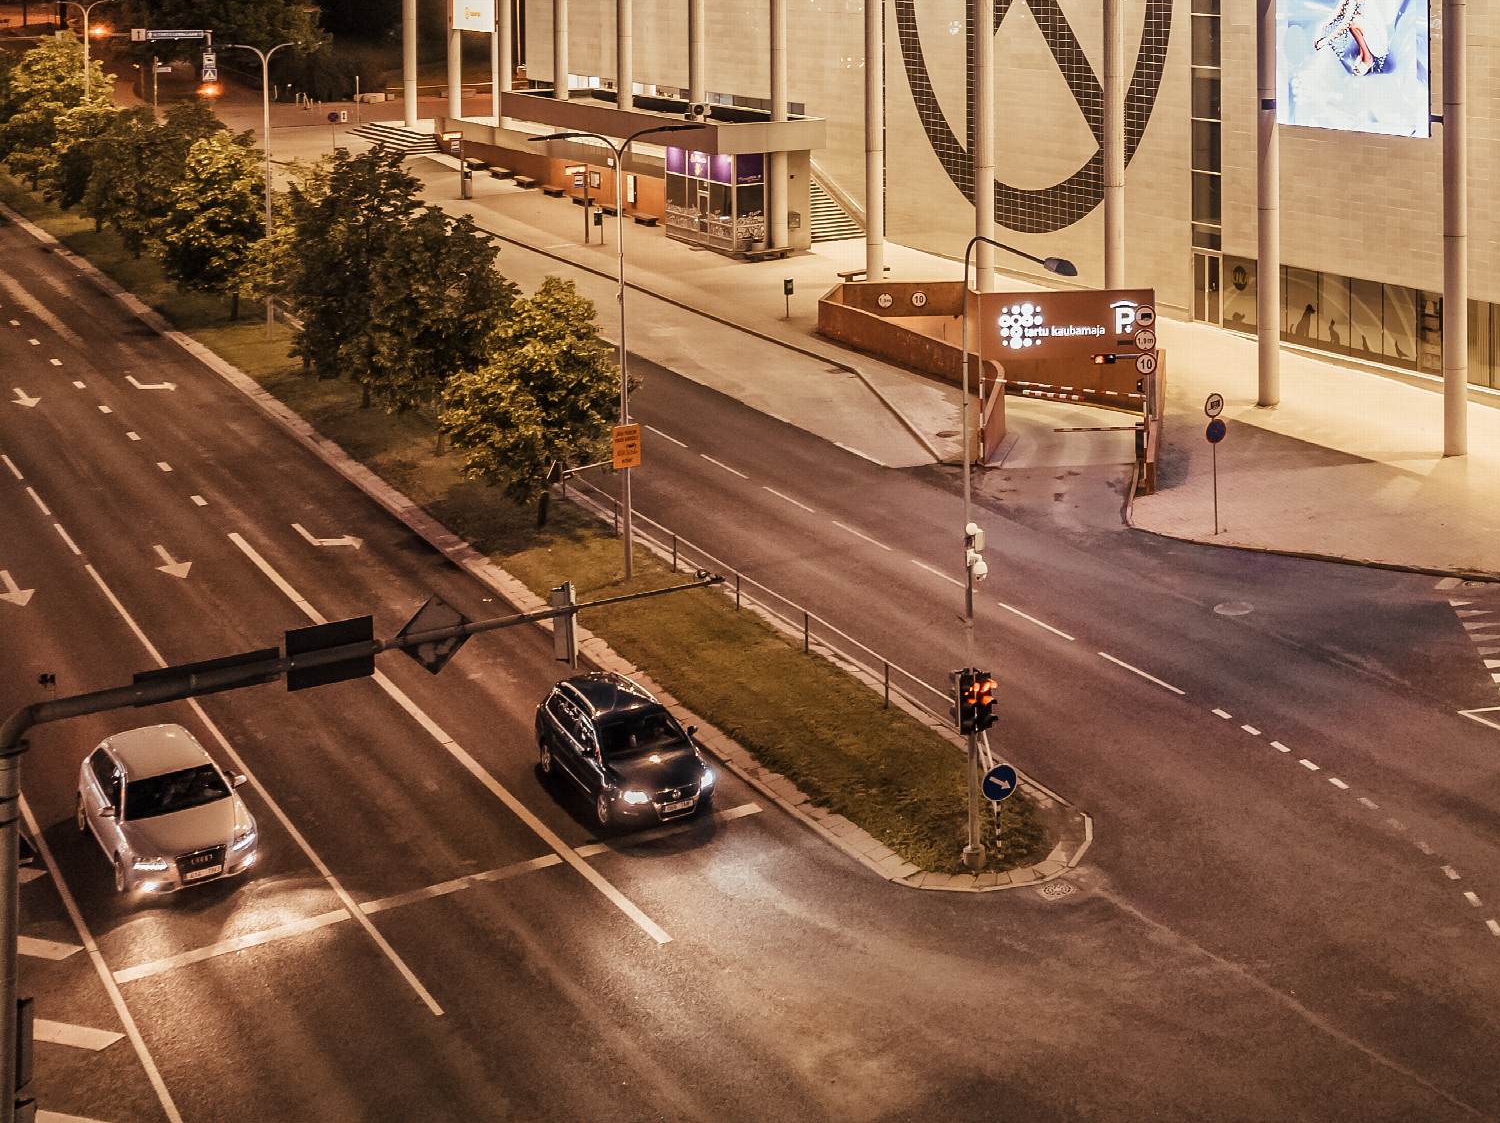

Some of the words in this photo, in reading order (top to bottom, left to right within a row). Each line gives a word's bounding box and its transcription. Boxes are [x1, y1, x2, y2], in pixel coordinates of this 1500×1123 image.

[914, 295, 924, 304] 10
[1024, 326, 1049, 337] tartu
[1051, 325, 1105, 337] kaubamaja
[1140, 359, 1153, 369] 10
